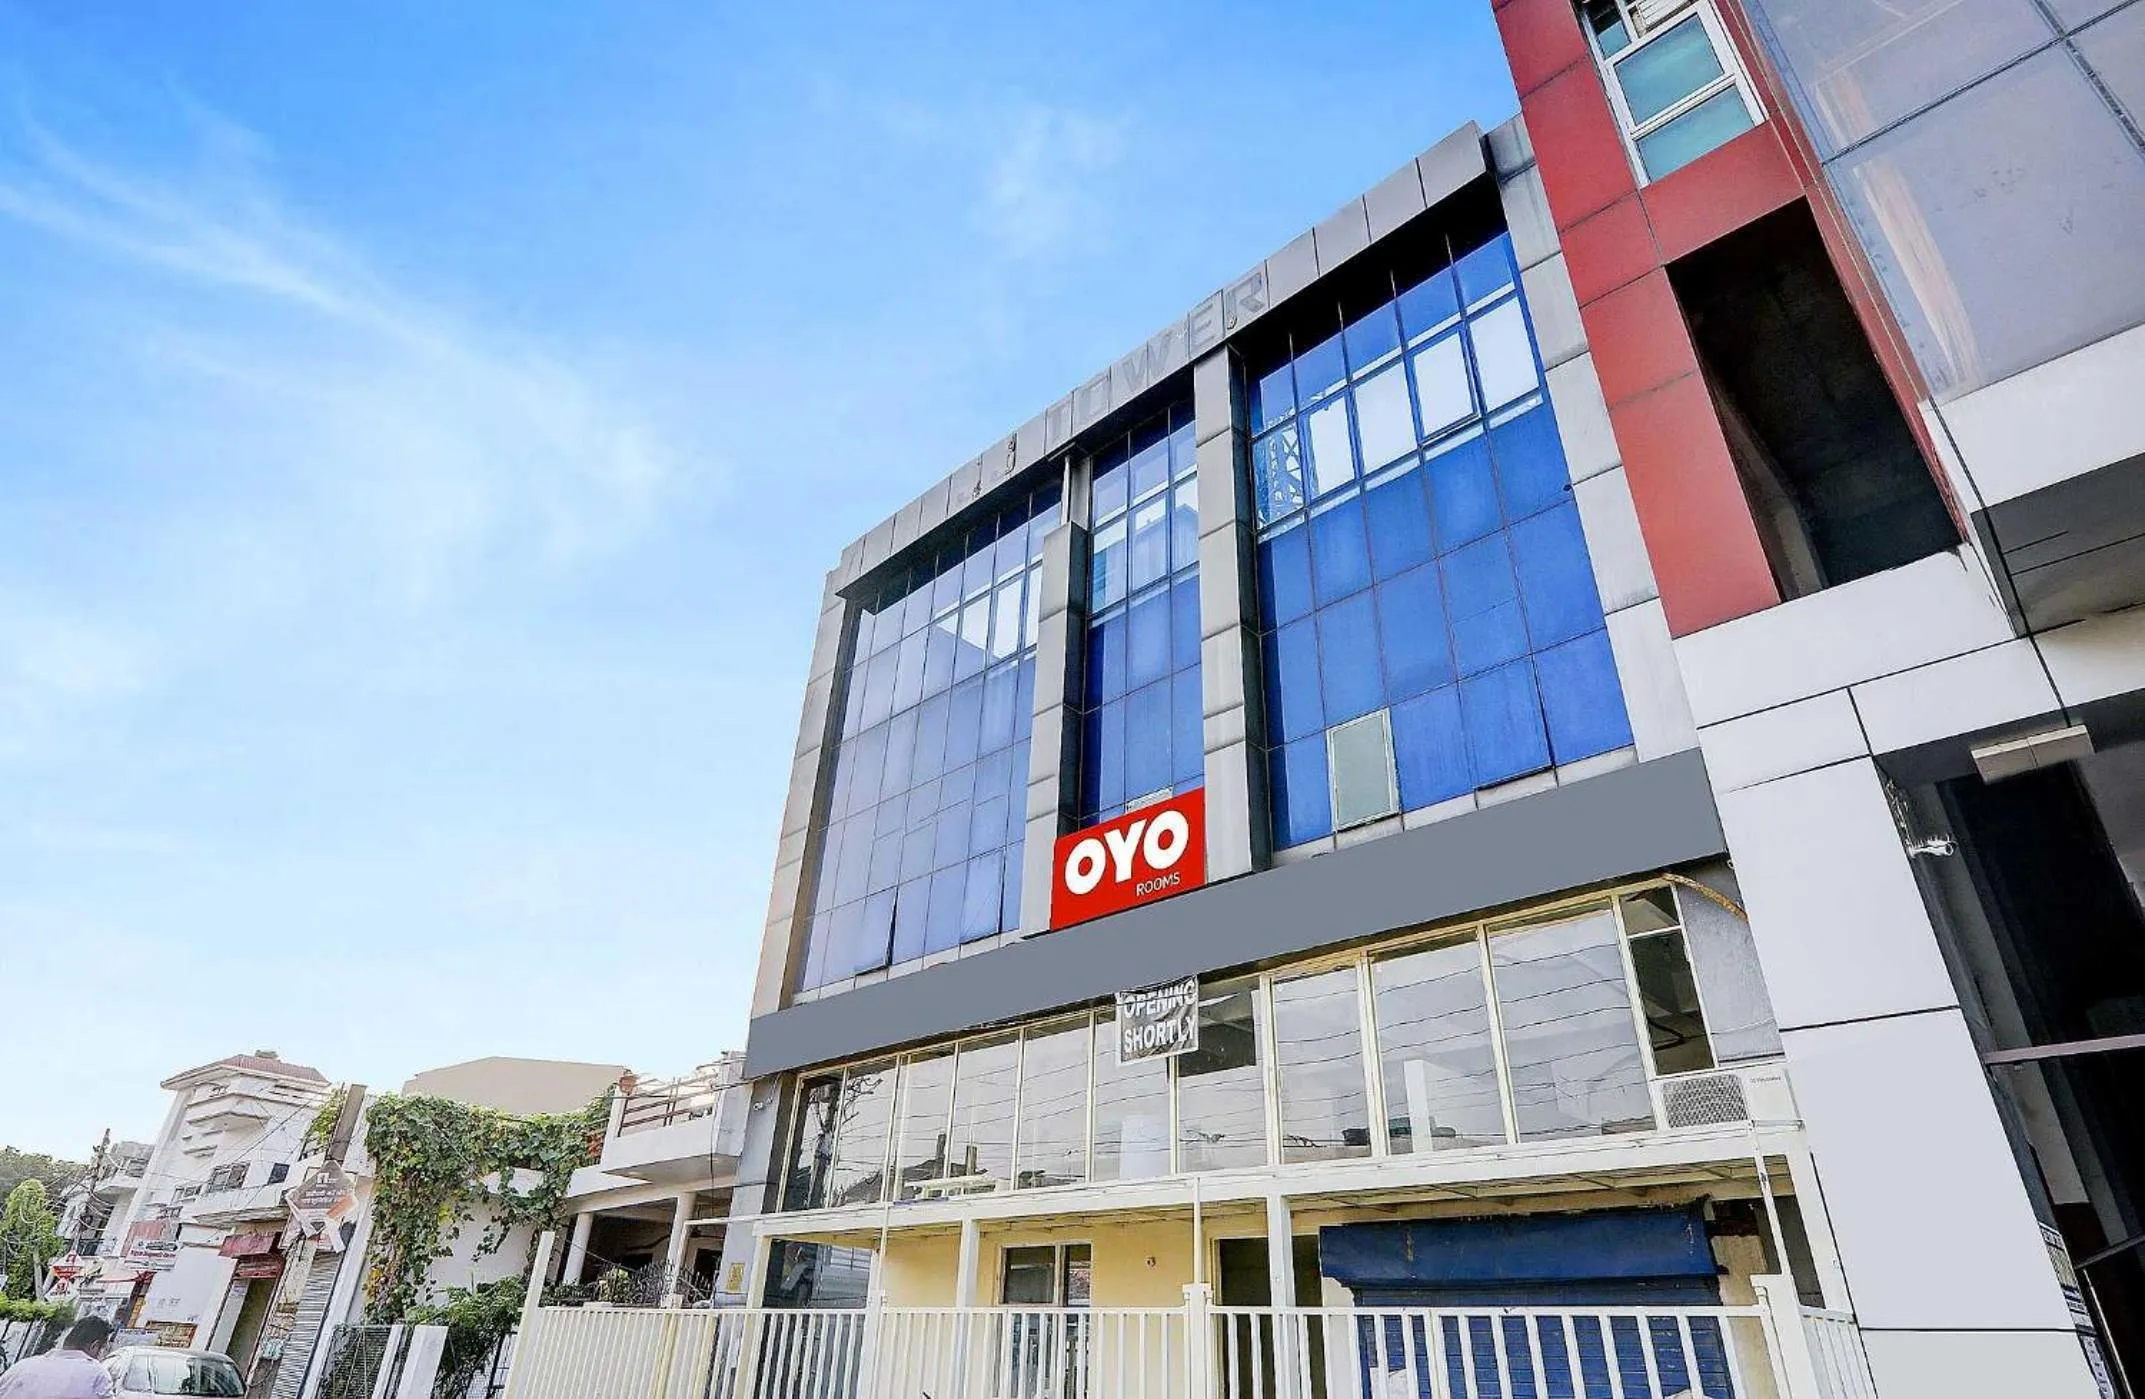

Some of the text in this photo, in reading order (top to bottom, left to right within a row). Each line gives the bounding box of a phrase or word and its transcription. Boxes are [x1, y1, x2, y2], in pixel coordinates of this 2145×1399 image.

[1047, 272, 1264, 445] TOWER
[1064, 810, 1190, 895] OYO
[1136, 872, 1180, 897] ROOMS
[1123, 979, 1196, 1018] OPENING
[1124, 1016, 1195, 1053] SHORTLY
